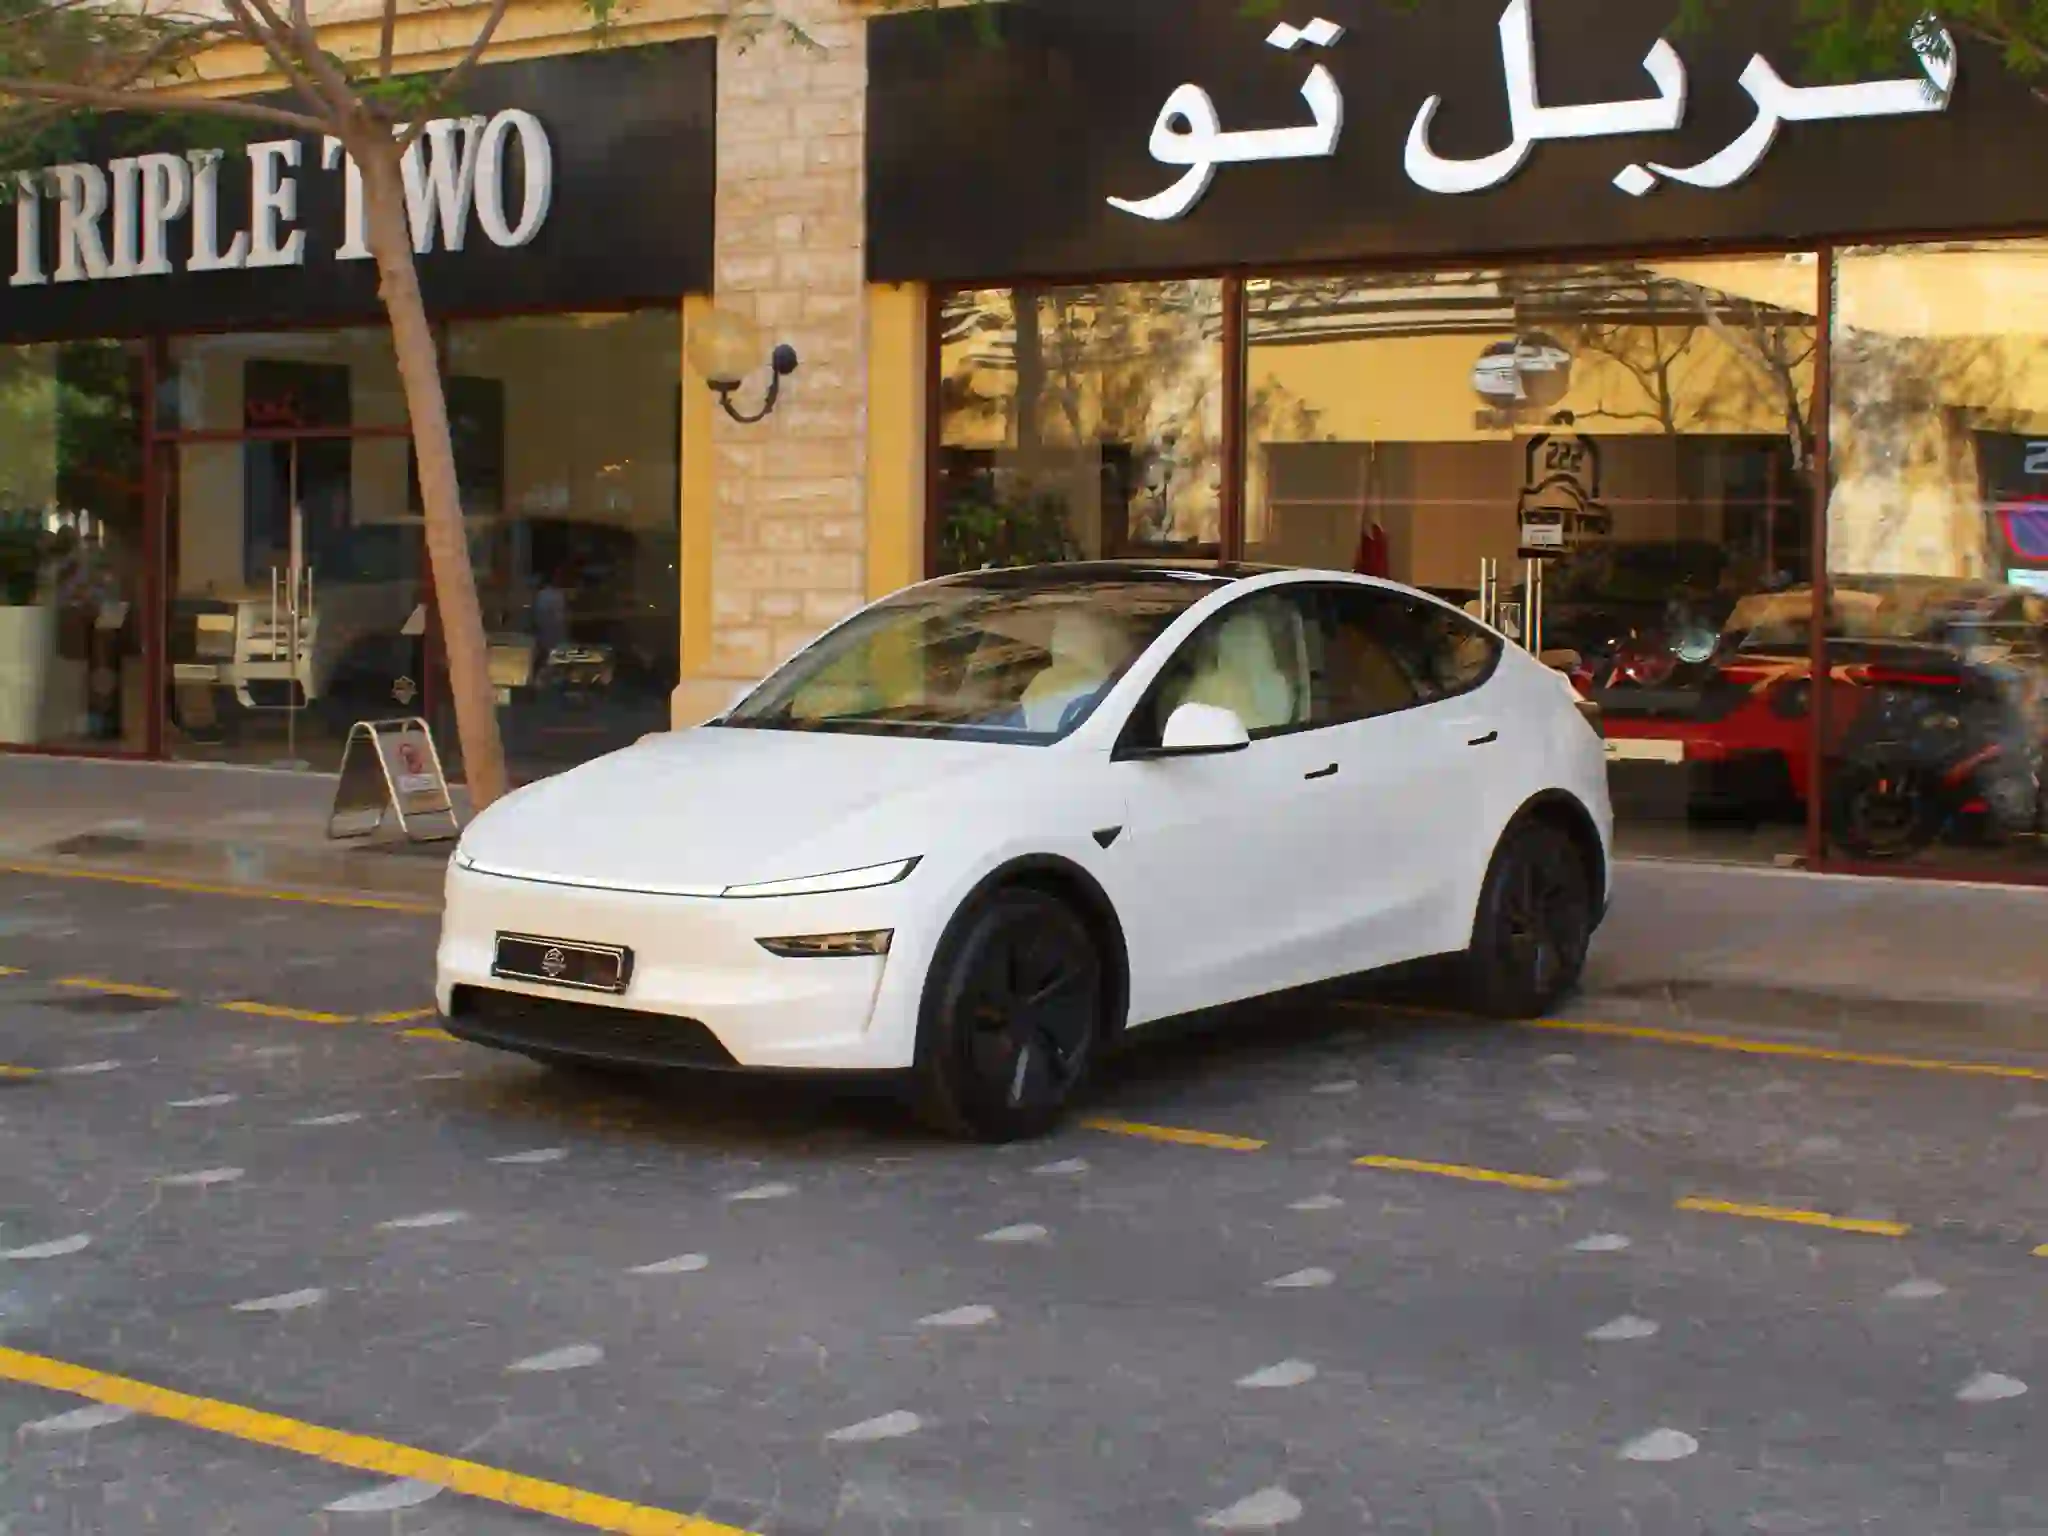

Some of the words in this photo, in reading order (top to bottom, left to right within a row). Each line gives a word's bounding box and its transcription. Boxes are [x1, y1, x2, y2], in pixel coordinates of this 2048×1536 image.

[6, 139, 306, 287] TRIPLE
[322, 108, 552, 261] TWO
[1106, 16, 1345, 222] تو
